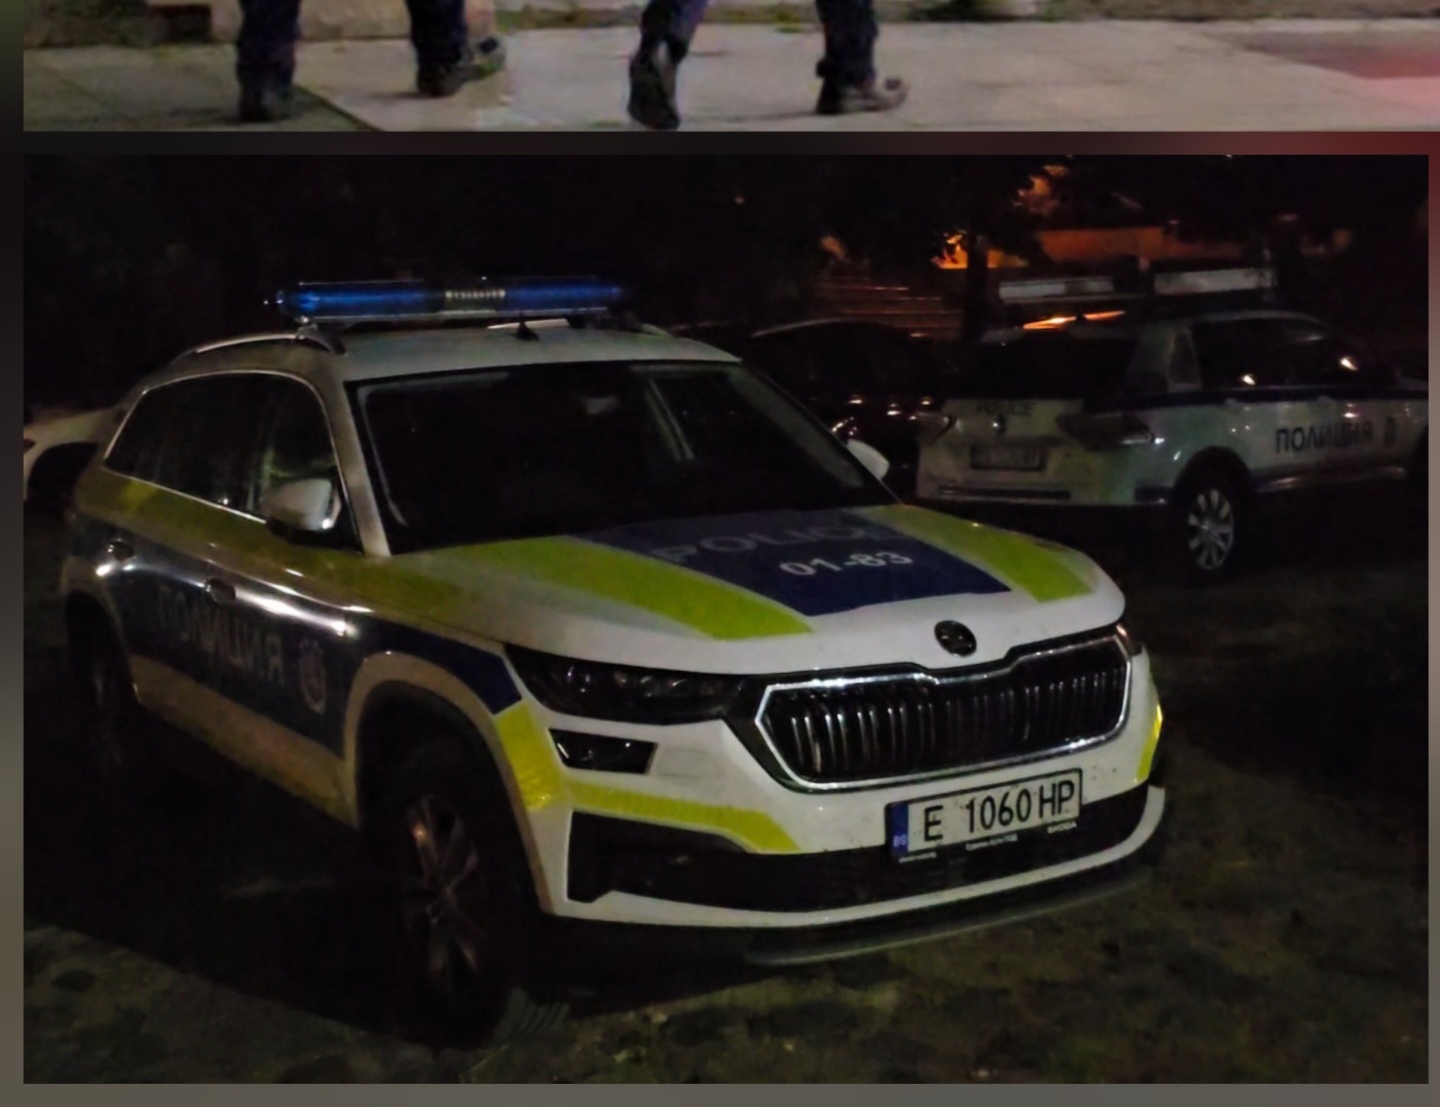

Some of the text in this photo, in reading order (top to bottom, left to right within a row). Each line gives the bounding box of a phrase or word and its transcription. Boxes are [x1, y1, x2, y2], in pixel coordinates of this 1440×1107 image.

[1275, 420, 1373, 454] ПОЛИЦИЯ
[779, 550, 914, 577] 01-83
[924, 779, 1075, 841] E 1060 HP
